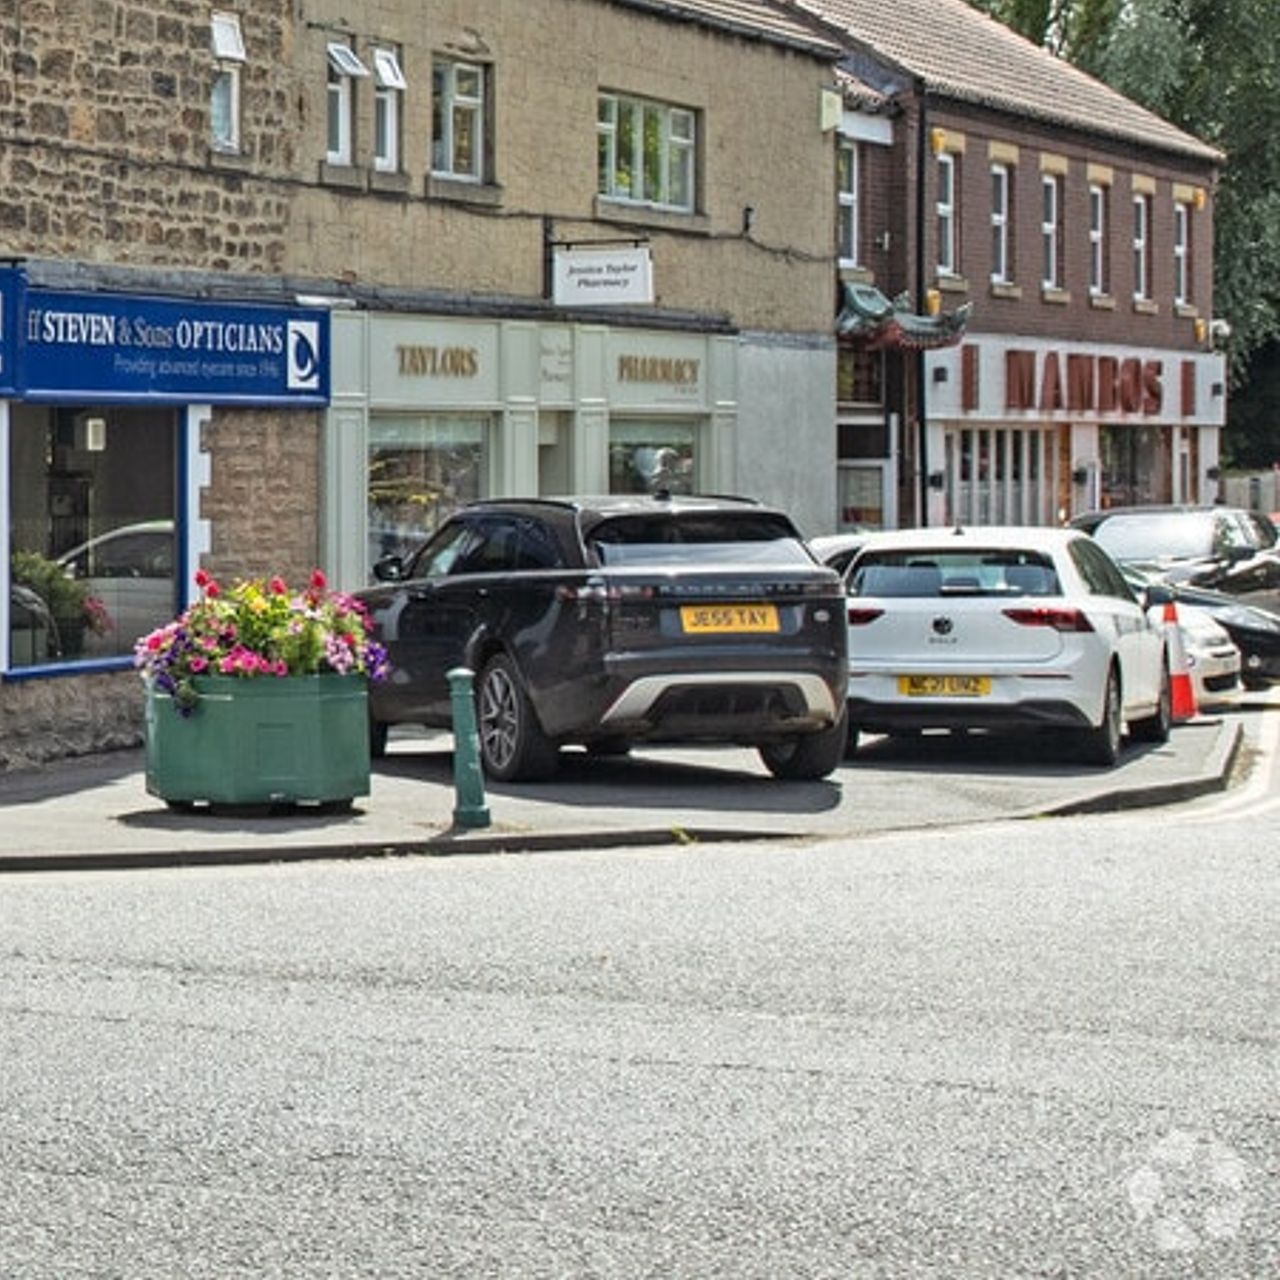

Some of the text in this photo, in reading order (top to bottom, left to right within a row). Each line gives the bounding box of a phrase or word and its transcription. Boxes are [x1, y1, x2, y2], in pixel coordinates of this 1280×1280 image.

[42, 310, 116, 345] STEVEN
[119, 316, 132, 347] &
[134, 316, 174, 348] Sons
[176, 320, 283, 354] OPTICIANS
[396, 344, 699, 385] TAYLORS PHARMACY
[1005, 350, 1164, 416] MAMBOS
